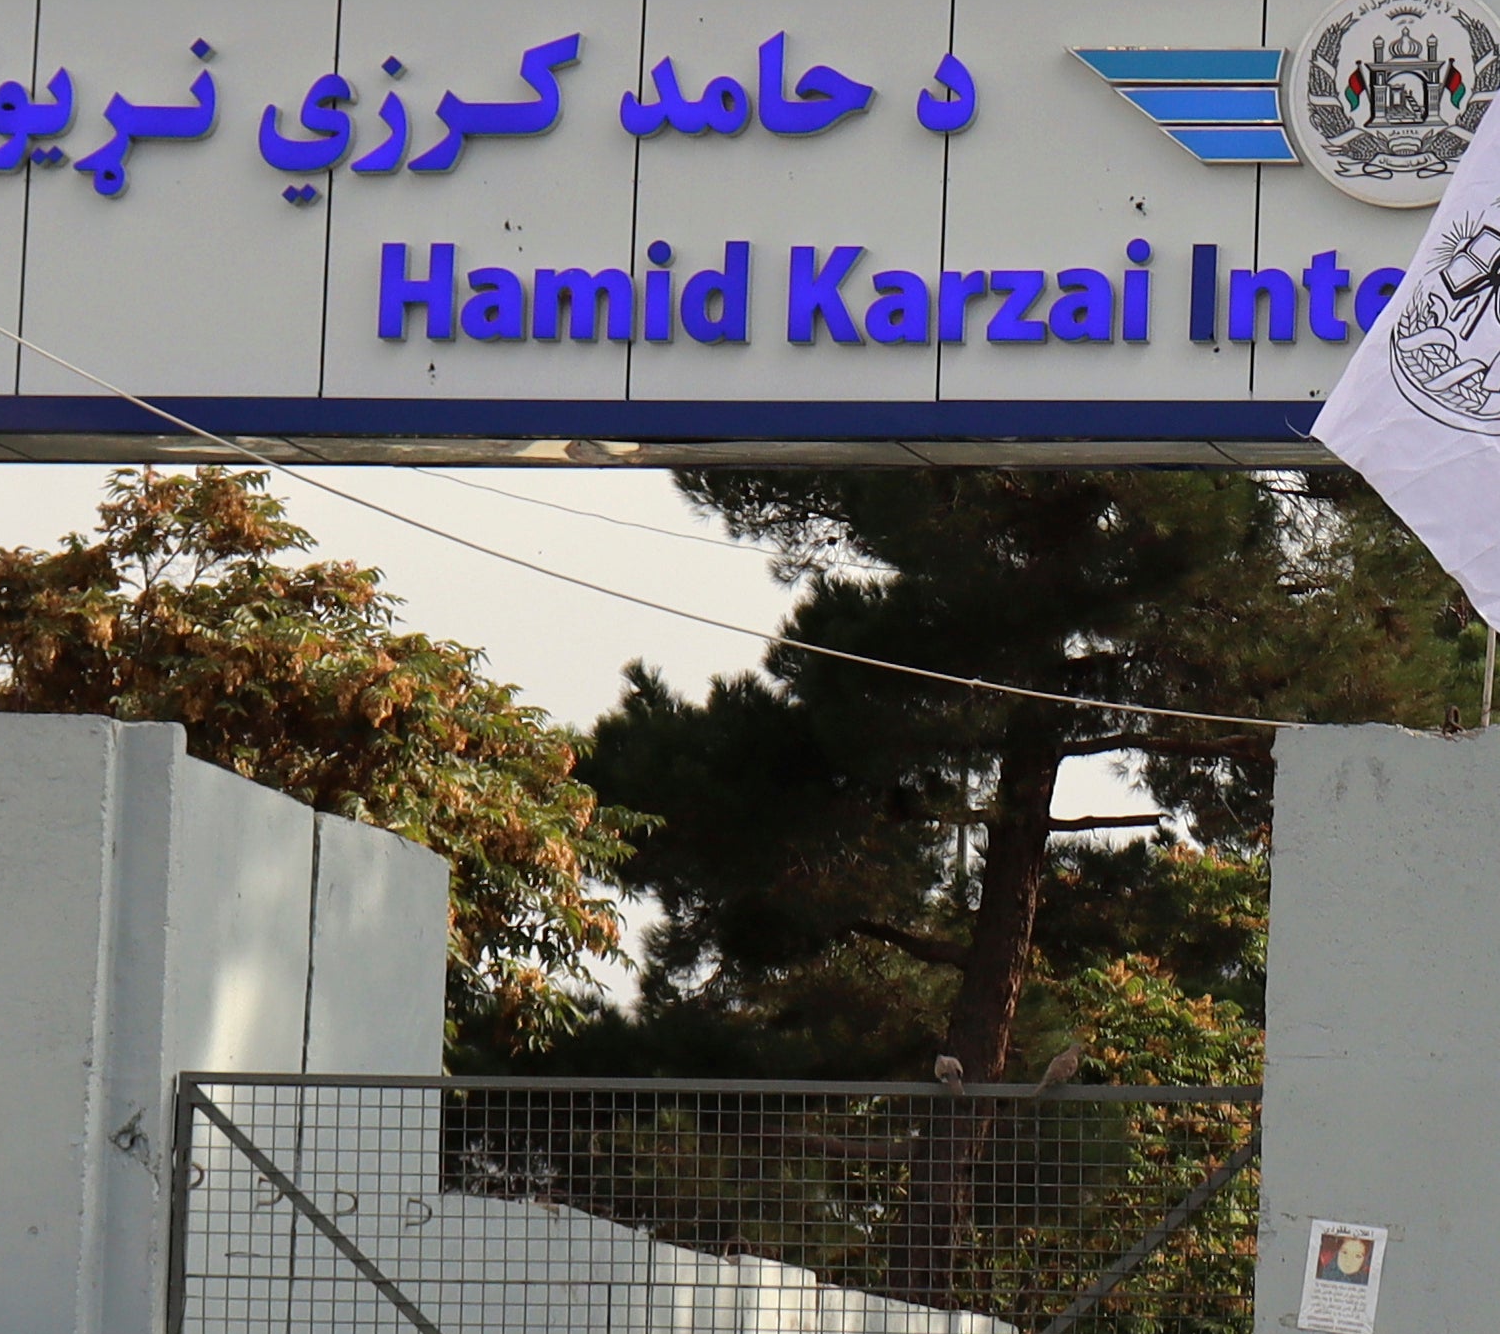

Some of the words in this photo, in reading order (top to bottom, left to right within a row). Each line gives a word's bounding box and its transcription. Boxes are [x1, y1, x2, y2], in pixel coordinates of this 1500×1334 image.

[619, 31, 874, 137] حامد
[916, 51, 977, 134] د
[378, 240, 752, 346] Hamid
[787, 238, 1153, 346] Karzai
